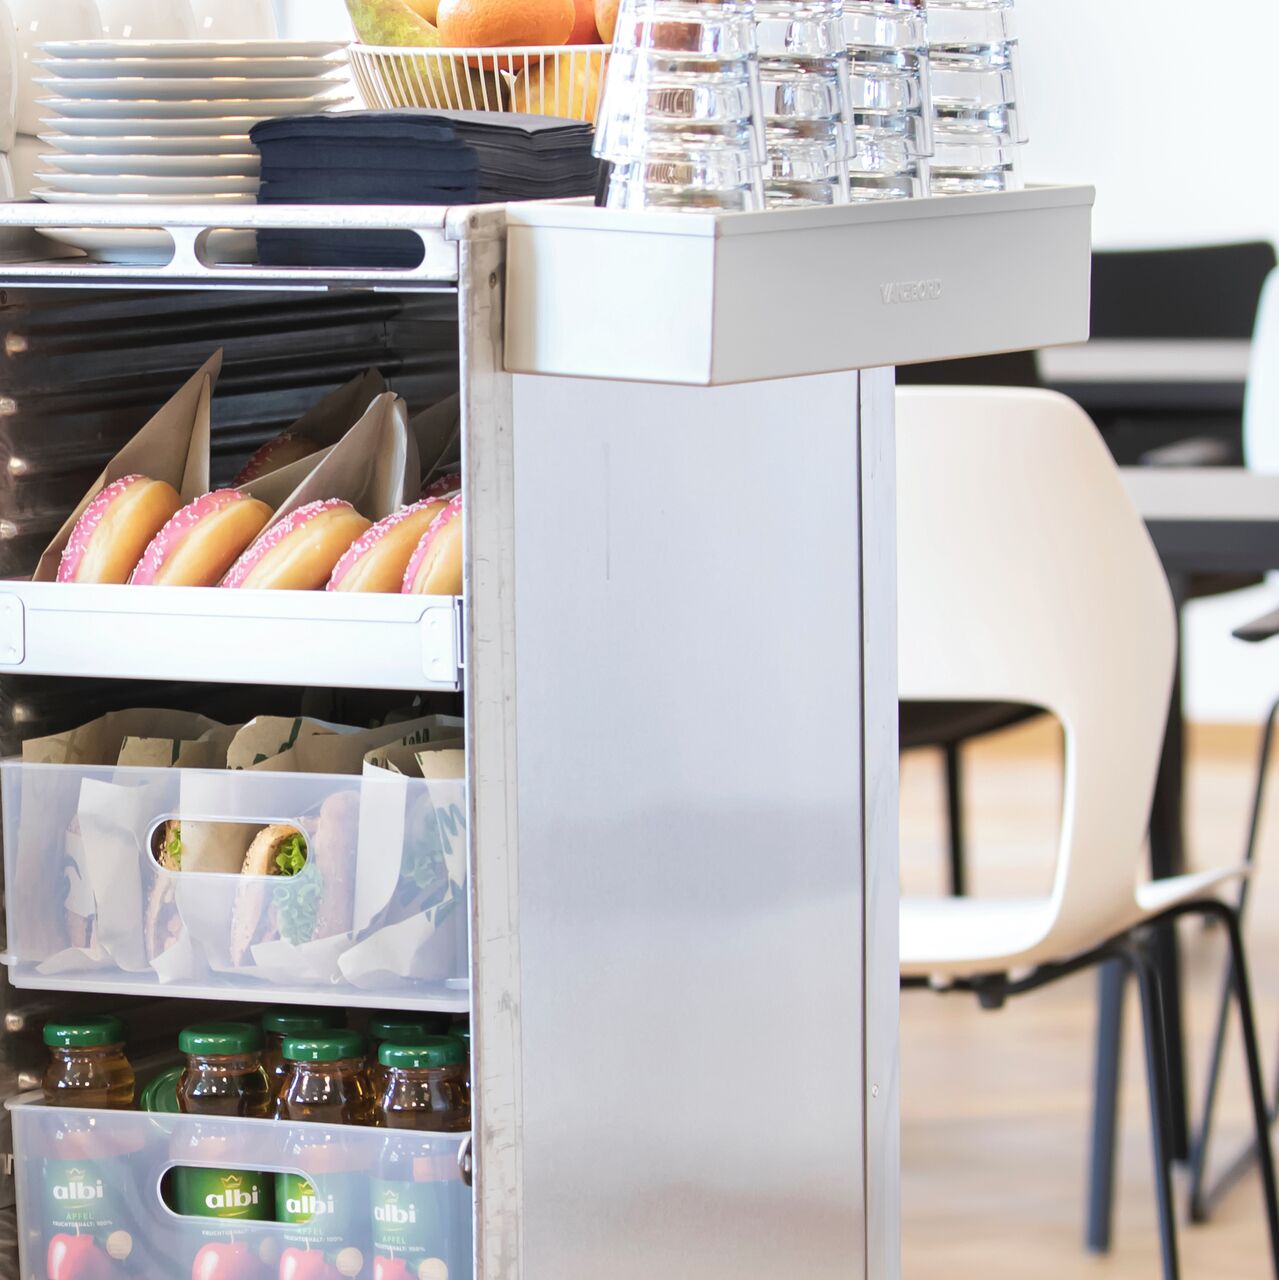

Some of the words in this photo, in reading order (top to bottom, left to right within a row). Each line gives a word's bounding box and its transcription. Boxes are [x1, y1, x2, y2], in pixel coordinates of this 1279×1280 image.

[53, 1178, 104, 1200] albi
[205, 1184, 258, 1208] albi
[286, 1194, 335, 1214] albi
[374, 1203, 417, 1224] albi
